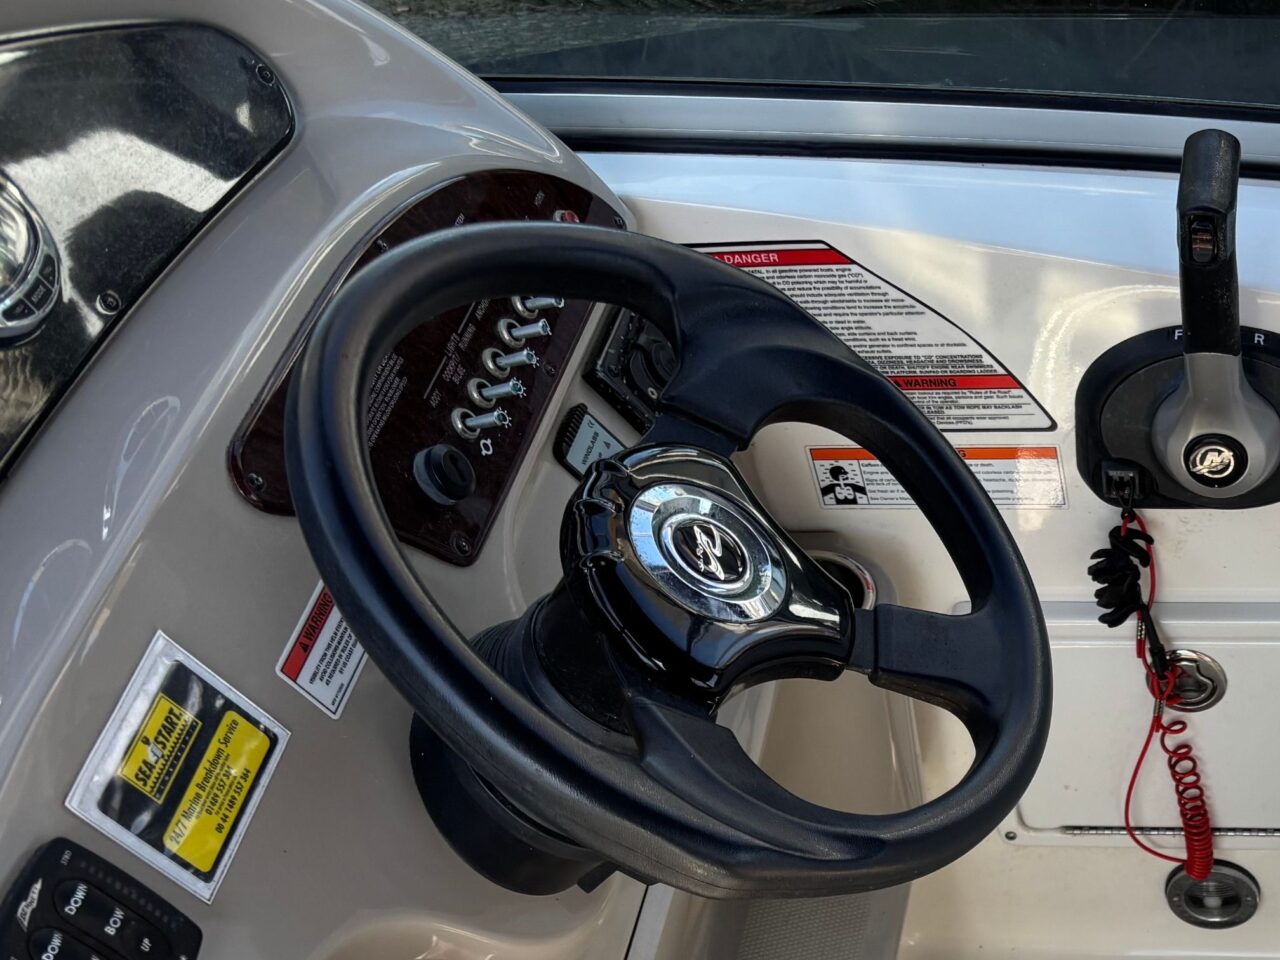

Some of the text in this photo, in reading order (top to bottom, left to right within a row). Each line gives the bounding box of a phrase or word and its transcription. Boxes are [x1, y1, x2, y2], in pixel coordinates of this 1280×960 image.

[724, 252, 778, 264] DANGER
[1254, 334, 1264, 344] R
[904, 379, 957, 388] WARNING
[579, 431, 600, 464] WINDLASS
[134, 708, 180, 786] SEA START
[170, 821, 187, 844] 24/7
[181, 790, 202, 821] Marine
[196, 746, 223, 791] Breakdown
[217, 717, 237, 746] Service
[205, 792, 220, 815] 01489
[215, 778, 226, 793] 557
[216, 823, 224, 833] 00
[220, 812, 229, 823] 44
[225, 795, 237, 812] 1489
[233, 781, 244, 796] 557
[240, 768, 250, 782] 364
[65, 884, 88, 915] DOWN
[105, 908, 125, 935] BOW
[141, 938, 152, 952] UP
